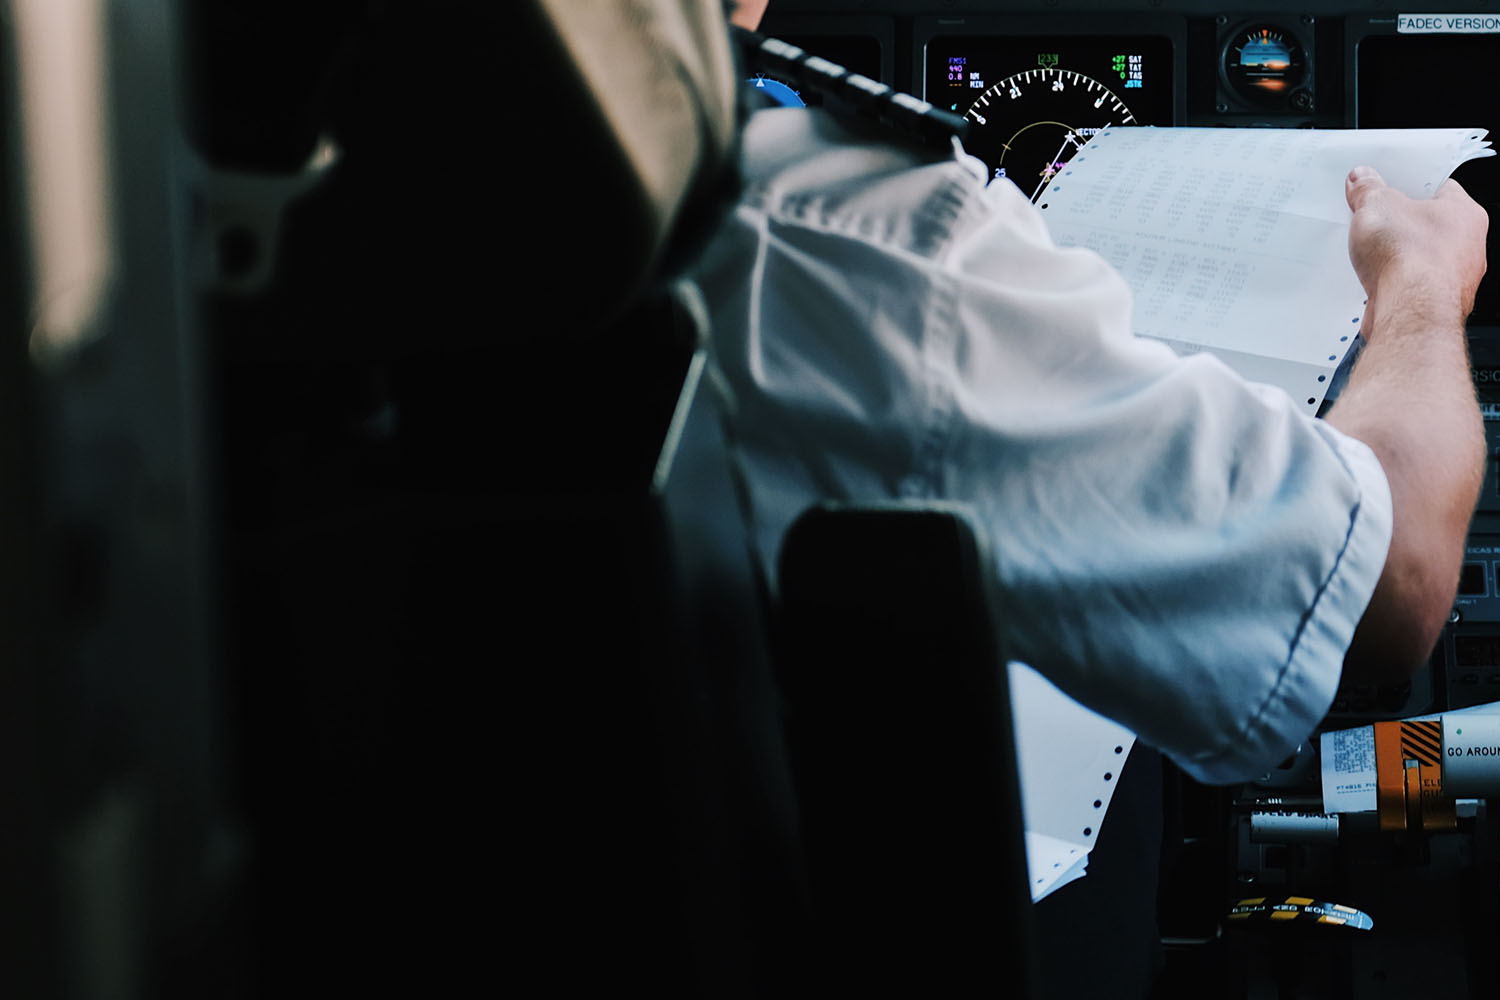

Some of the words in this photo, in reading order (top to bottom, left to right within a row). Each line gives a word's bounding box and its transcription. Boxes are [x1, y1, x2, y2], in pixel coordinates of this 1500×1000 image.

[1398, 18, 1442, 30] FADEC
[1039, 54, 1058, 63] 233
[1111, 55, 1126, 64] +27
[1128, 55, 1143, 64] SAT
[1111, 63, 1126, 72] +27
[1128, 63, 1143, 72] TAT
[948, 73, 963, 81] 0.8
[969, 72, 980, 81] NM
[1119, 72, 1126, 80] 0
[1128, 72, 1143, 80] TAS
[969, 80, 984, 89] MIN
[1052, 80, 1065, 92] 24
[994, 168, 1006, 178] 25
[1447, 747, 1464, 758] GO
